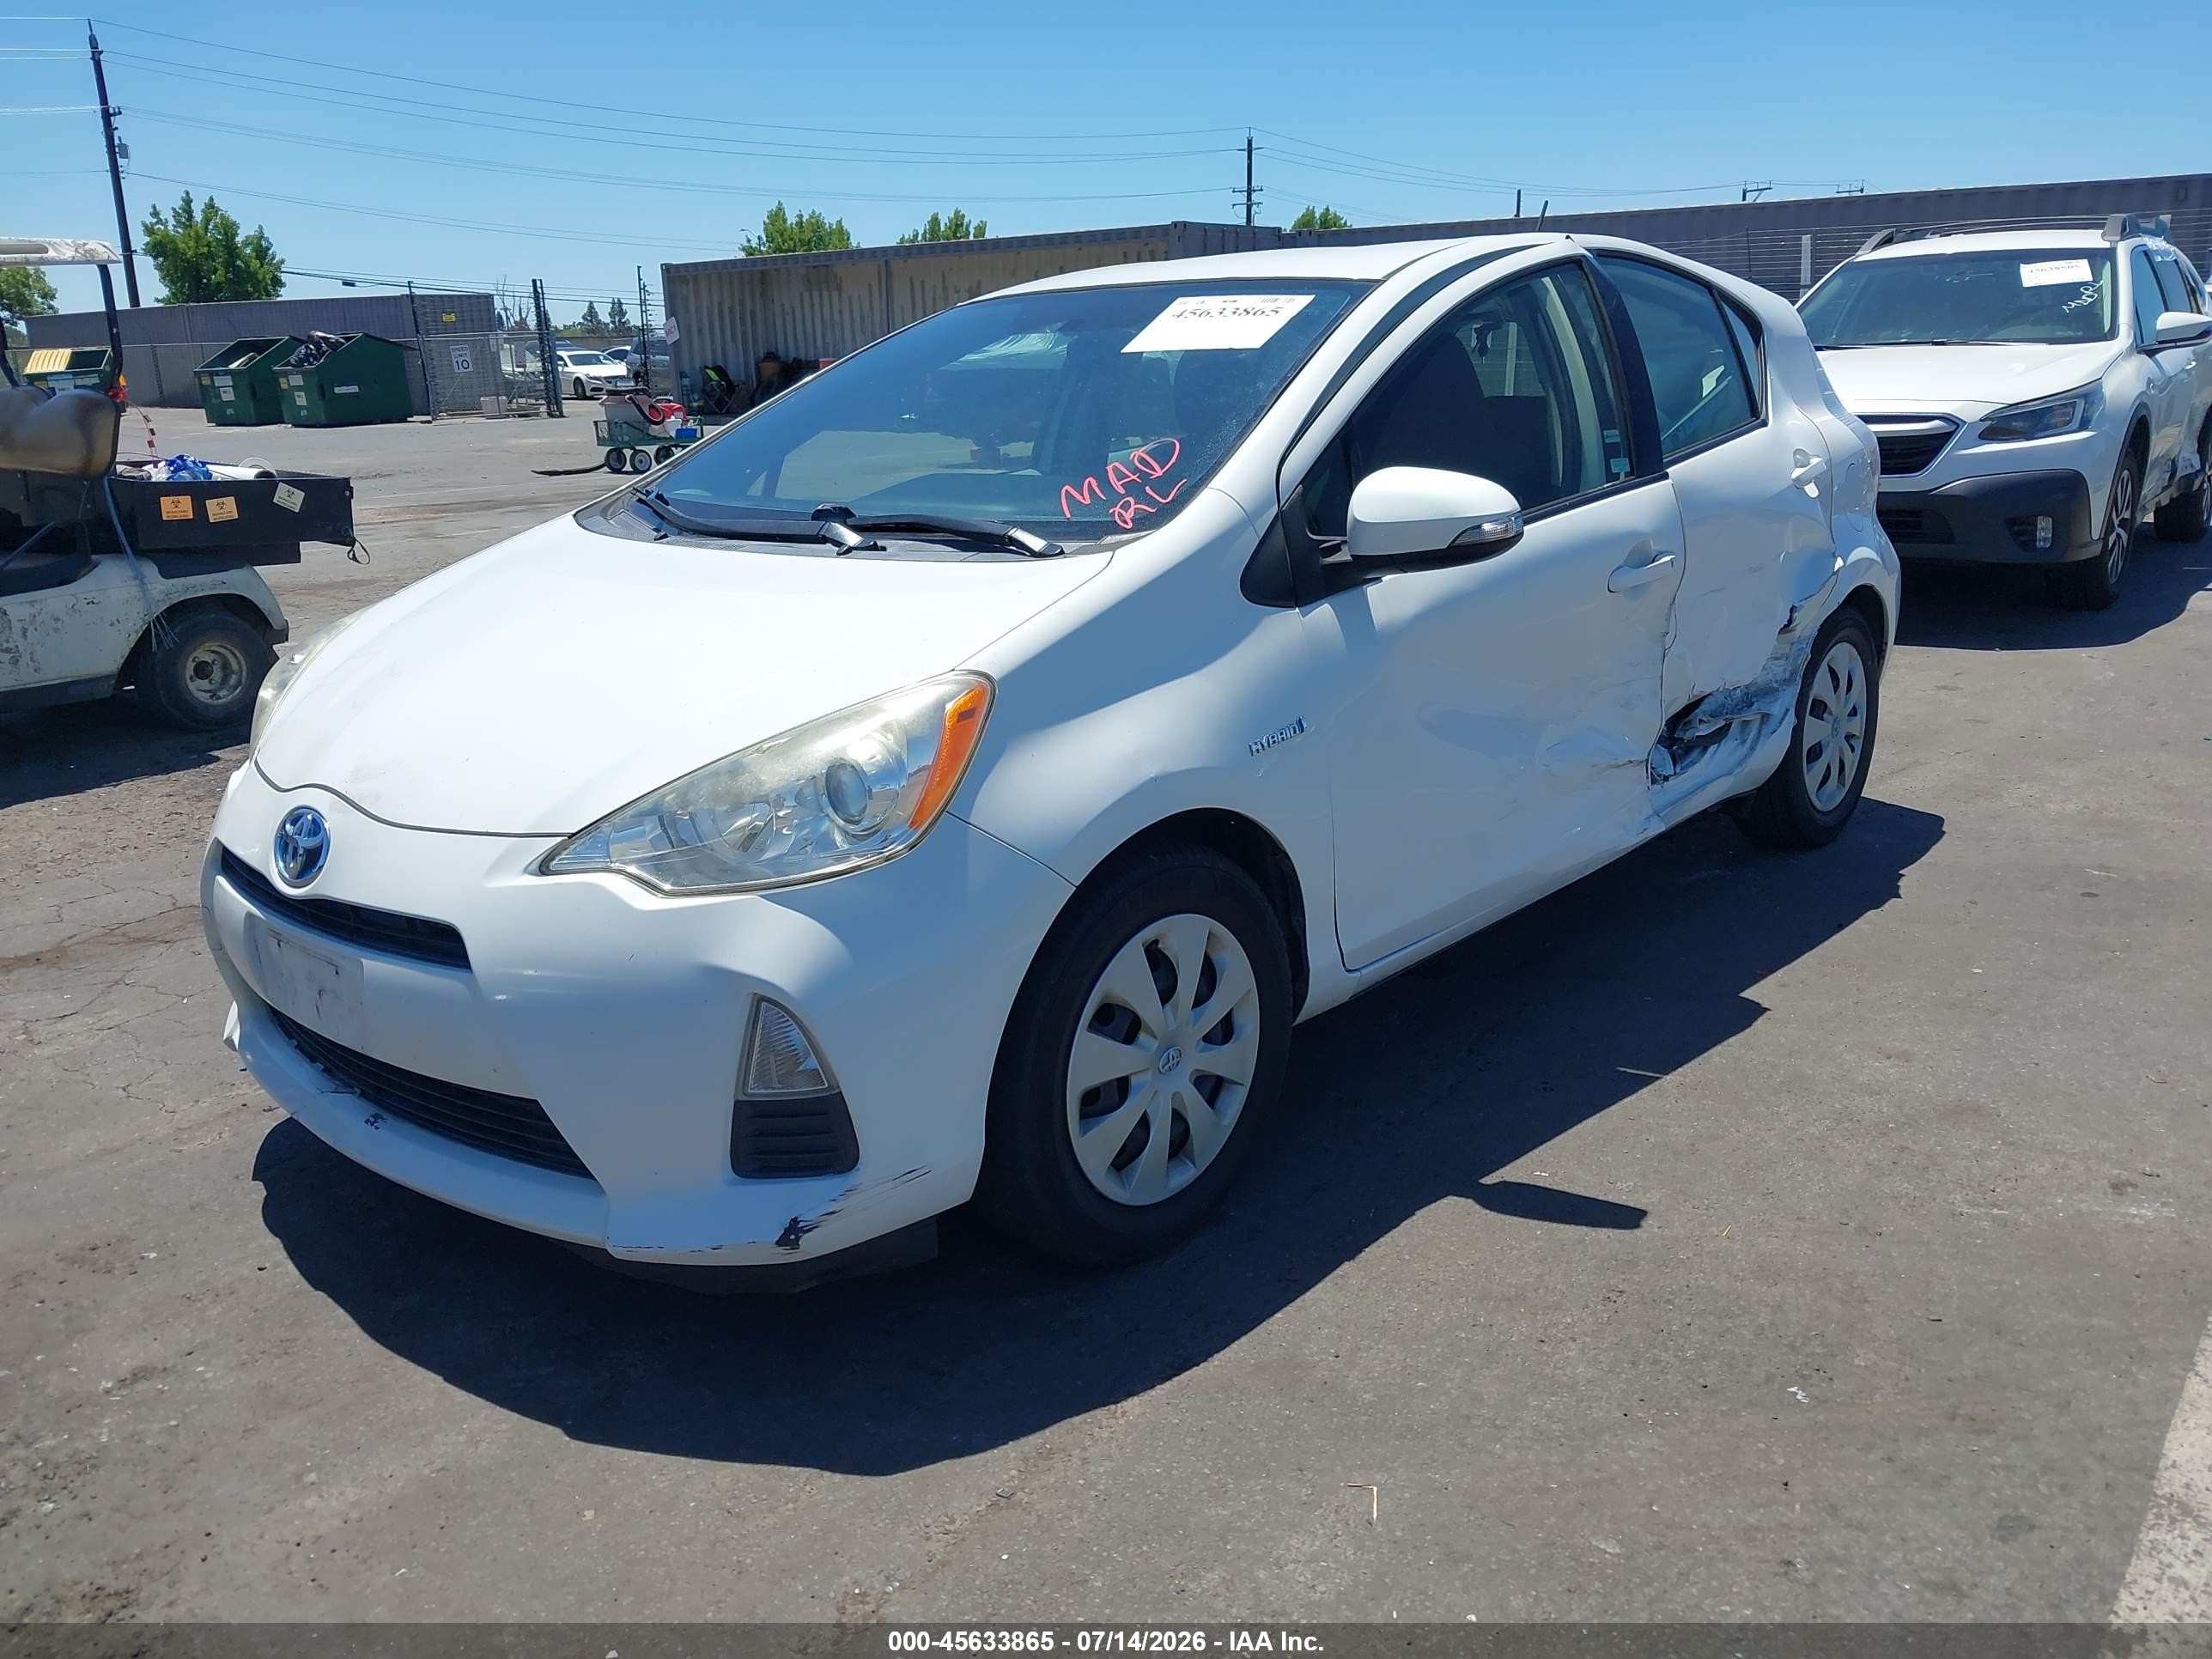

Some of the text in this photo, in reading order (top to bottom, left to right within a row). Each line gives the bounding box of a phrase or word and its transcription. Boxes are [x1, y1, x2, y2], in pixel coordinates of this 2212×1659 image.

[1170, 307, 1286, 319] 45633865
[455, 359, 471, 370] 10
[1060, 438, 1181, 519] MAD
[1109, 478, 1188, 529] RL
[1248, 720, 1302, 757] HYBRID
